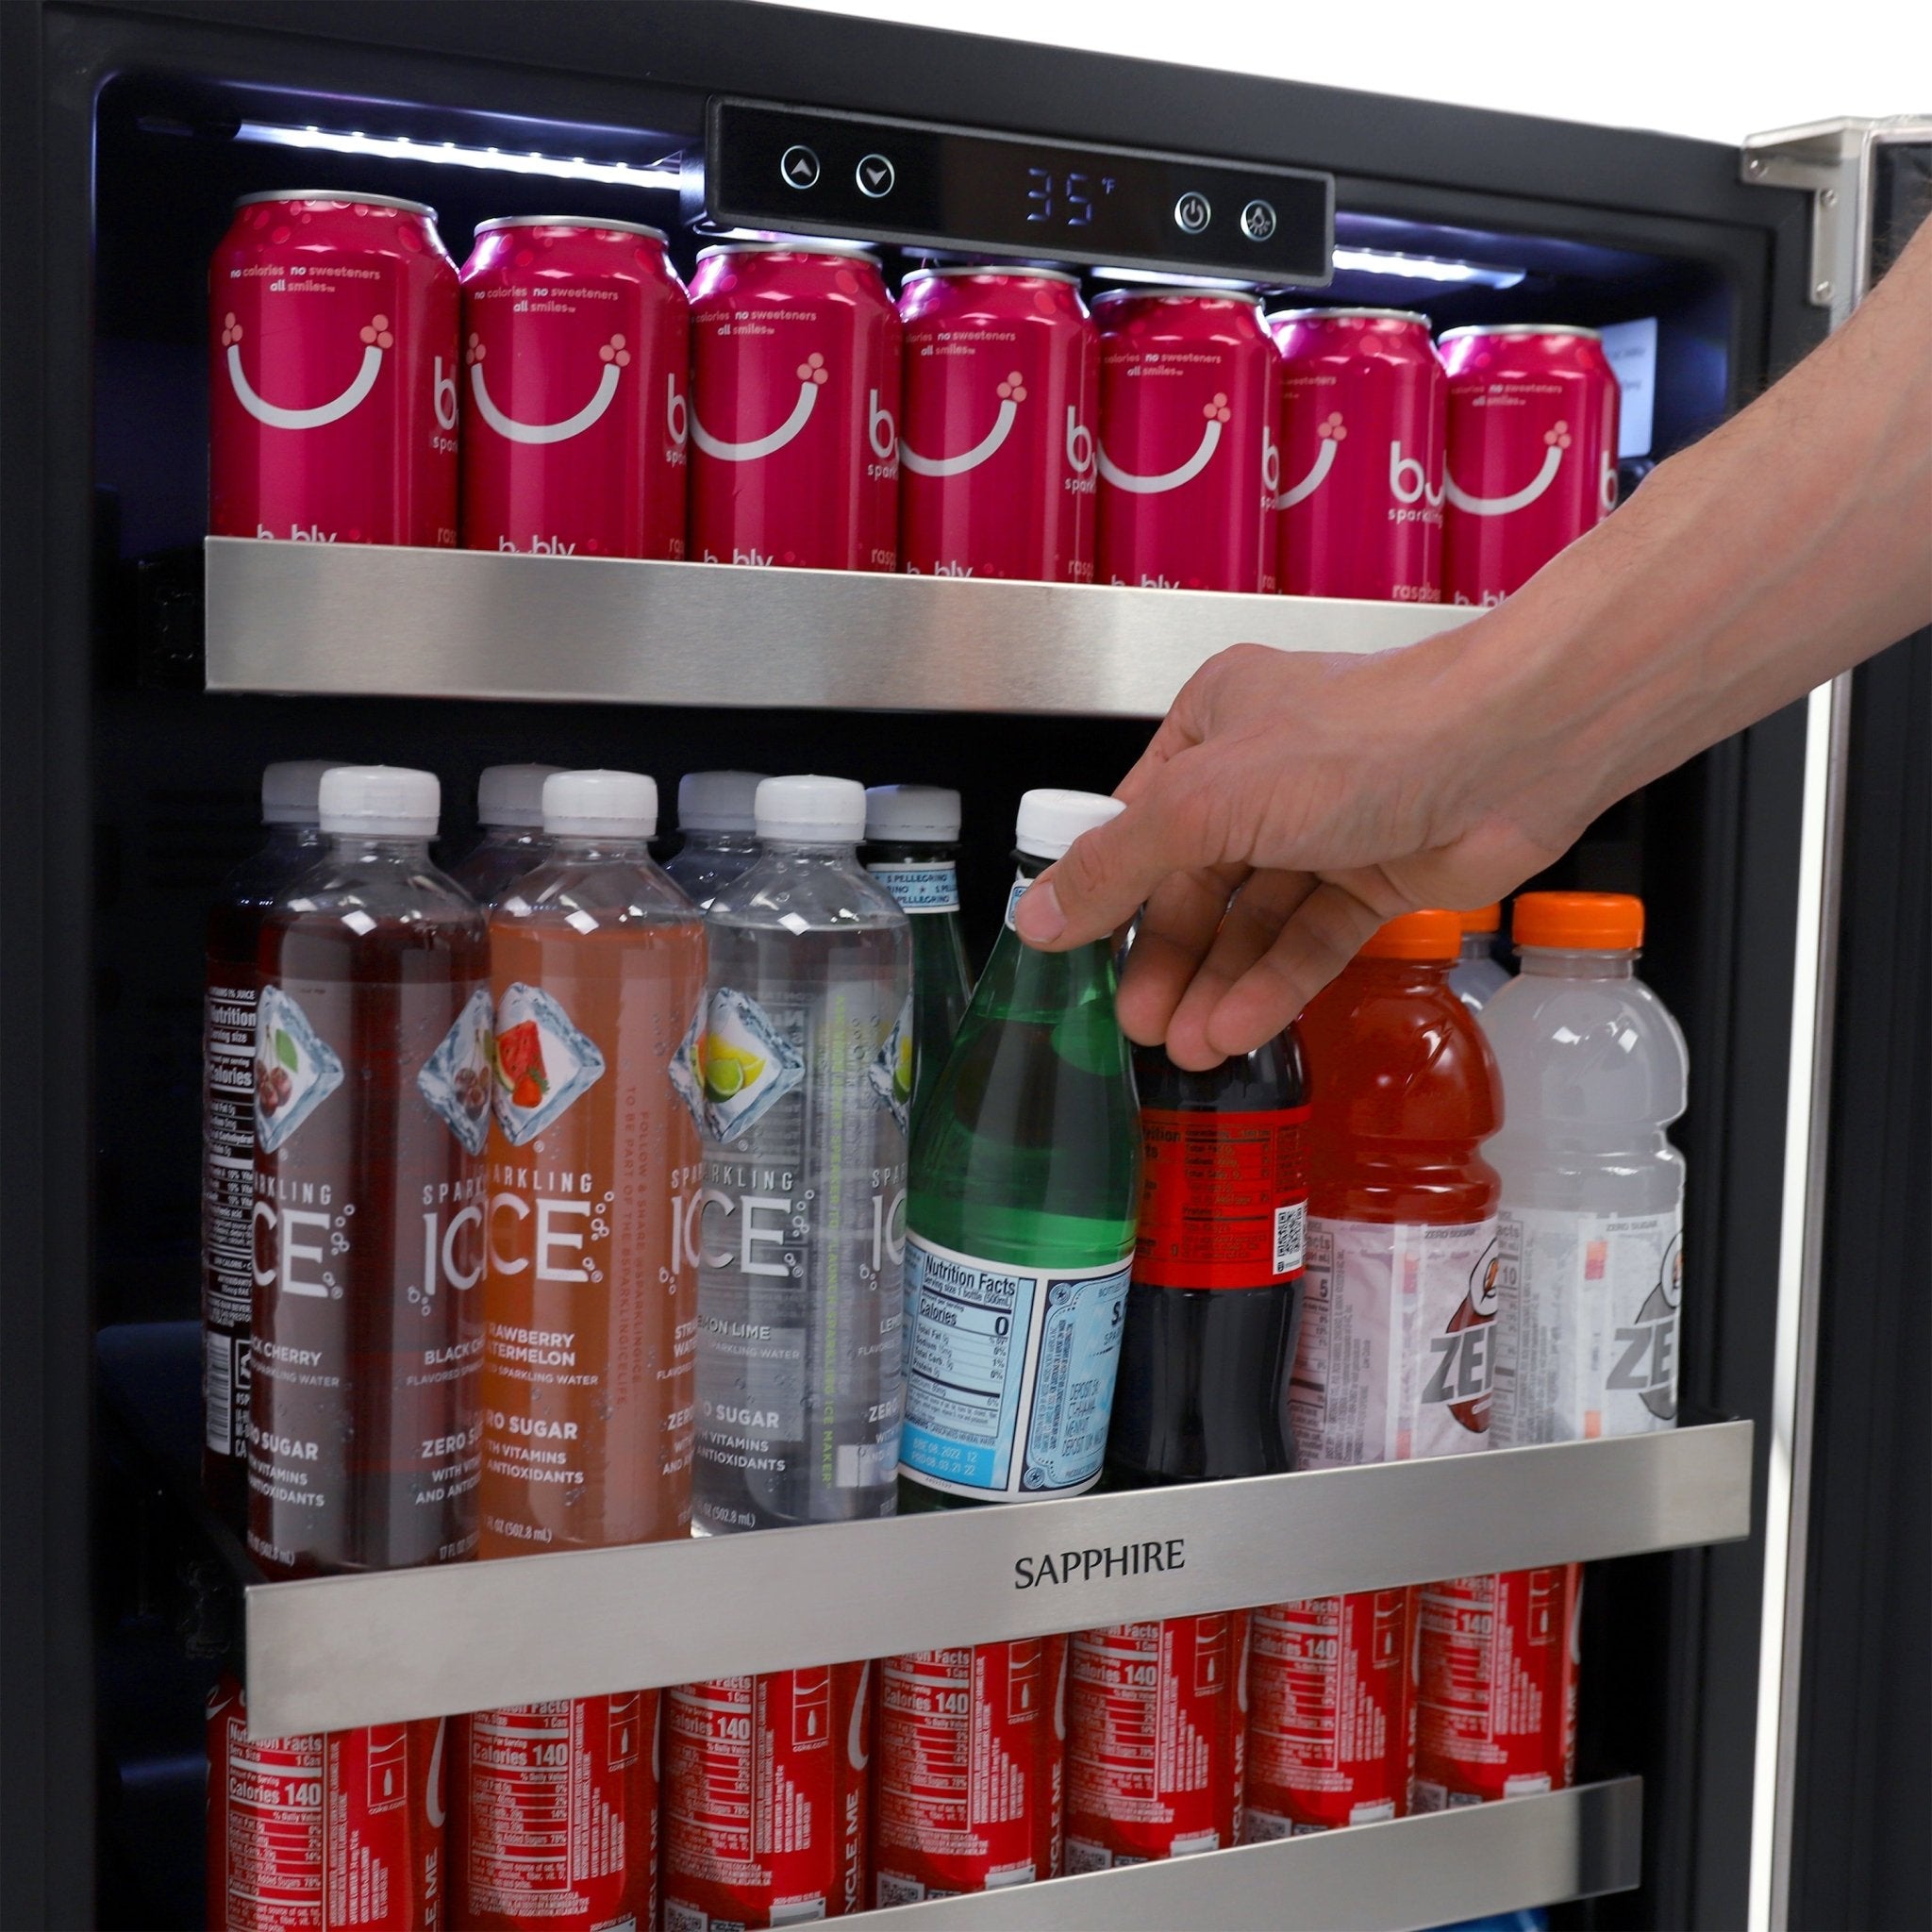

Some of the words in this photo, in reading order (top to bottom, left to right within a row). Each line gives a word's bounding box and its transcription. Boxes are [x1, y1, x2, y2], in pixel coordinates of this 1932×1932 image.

[1026, 168, 1092, 226] 35
[243, 264, 284, 277] calories
[291, 266, 307, 275] no
[308, 266, 380, 280] sweeteners
[270, 279, 286, 291] all
[487, 286, 527, 298] calories
[533, 288, 549, 297] no
[551, 287, 619, 301] sweeteners
[513, 301, 528, 313] all
[735, 311, 748, 320] no
[751, 310, 817, 321] sweeteners
[718, 325, 731, 336] all
[938, 332, 951, 341] no
[953, 331, 1016, 341] sweeteners
[921, 345, 933, 357] all
[1145, 354, 1158, 362] no
[1161, 353, 1222, 364] sweeteners
[1127, 366, 1141, 376] all
[712, 1164, 792, 1191] RKLING
[489, 1192, 591, 1283] CE
[253, 1201, 330, 1298] CE
[423, 1206, 487, 1295] IC
[924, 1255, 974, 1289] Nutrition
[979, 1274, 1016, 1296] Facts
[920, 1298, 958, 1326] Calories
[994, 1316, 1009, 1337] 0
[732, 1323, 772, 1341] LIME
[264, 1341, 322, 1368] CHERRY
[425, 1343, 470, 1366] BLACK
[760, 1348, 800, 1359] WATER
[299, 1374, 340, 1388] WATER
[557, 1374, 599, 1386] WATER
[509, 1415, 578, 1441] SUGAR
[716, 1404, 780, 1429] SUGAR
[262, 1432, 319, 1461] SUGAR
[422, 1434, 465, 1458] ZERO
[501, 1443, 566, 1465] VITAMINS
[710, 1432, 769, 1453] VITAMINS
[822, 1430, 834, 1485] MAKER
[258, 1462, 308, 1487] VITAMINS
[432, 1465, 462, 1483] WITH
[415, 1488, 445, 1506] AND
[1014, 1539, 1186, 1590] SAPPHIRE
[1305, 1639, 1338, 1659] 140
[1124, 1664, 1157, 1687] 140
[936, 1692, 969, 1715] 140
[717, 1716, 751, 1740] 140
[303, 1755, 321, 1767] Can
[473, 1742, 528, 1767] Calories
[532, 1742, 569, 1767] 140
[229, 1776, 280, 1805] Calories
[284, 1782, 322, 1807] 140
[425, 1847, 438, 1894] ME
